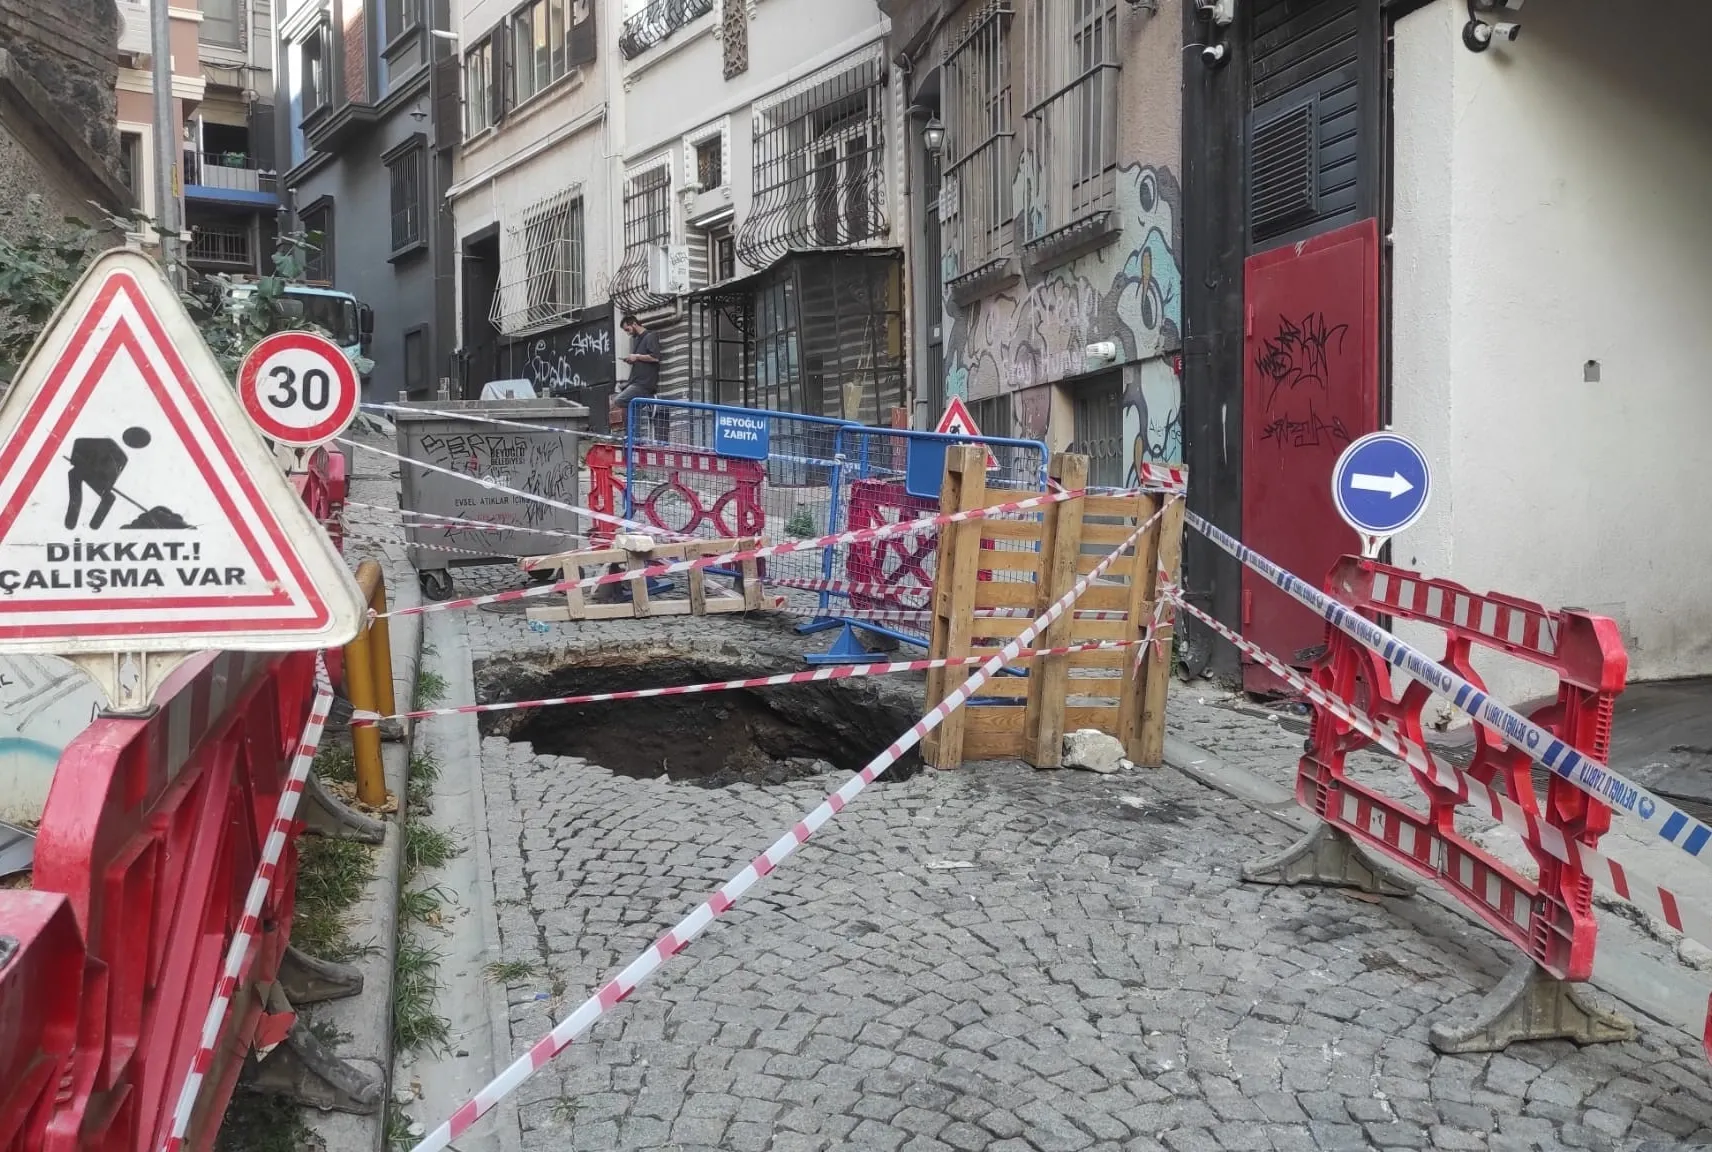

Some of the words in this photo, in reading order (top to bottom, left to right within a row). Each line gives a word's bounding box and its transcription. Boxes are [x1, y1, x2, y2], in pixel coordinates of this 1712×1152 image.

[267, 365, 330, 411] 30
[719, 415, 764, 430] BEYOĞLU
[723, 428, 758, 441] ZABITA
[454, 498, 477, 507] EVSEL
[480, 496, 510, 505] ATIKLAR
[46, 538, 201, 562] DİKKAT.!
[0, 567, 165, 594] ÇALIŞMA
[176, 566, 247, 586] VAR
[1579, 761, 1607, 793] ZABITA
[1602, 775, 1638, 811] BEYOĞLU
